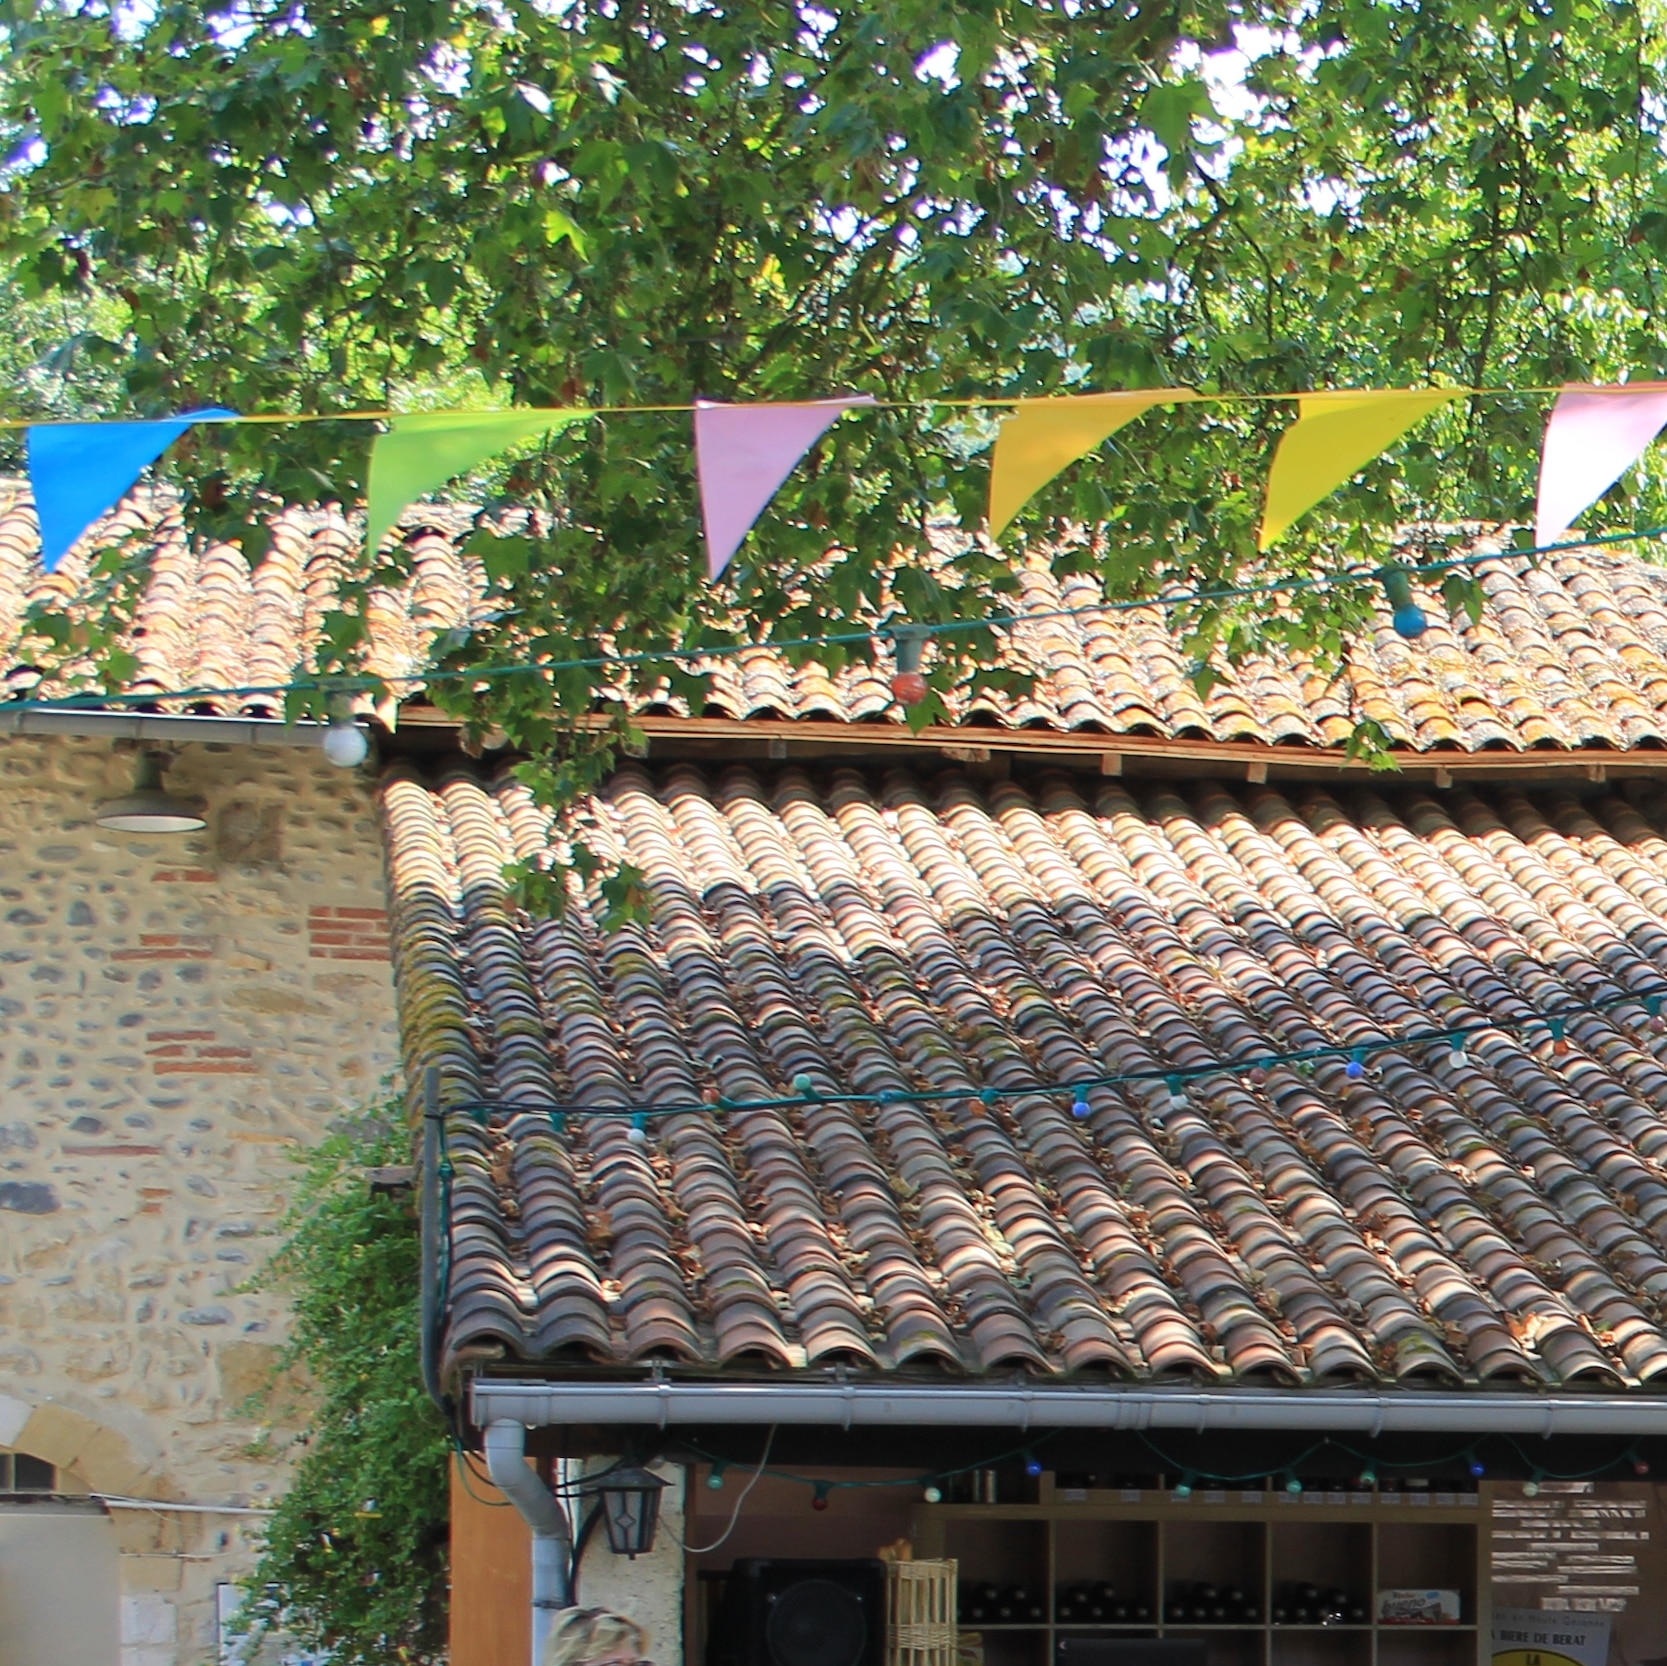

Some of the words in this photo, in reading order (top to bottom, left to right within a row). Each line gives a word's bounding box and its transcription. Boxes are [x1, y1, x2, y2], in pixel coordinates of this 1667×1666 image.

[1500, 1629, 1529, 1643] BIERE
[1534, 1632, 1549, 1645] DE
[1552, 1633, 1587, 1646] BERAT
[1526, 1653, 1541, 1666] LA
